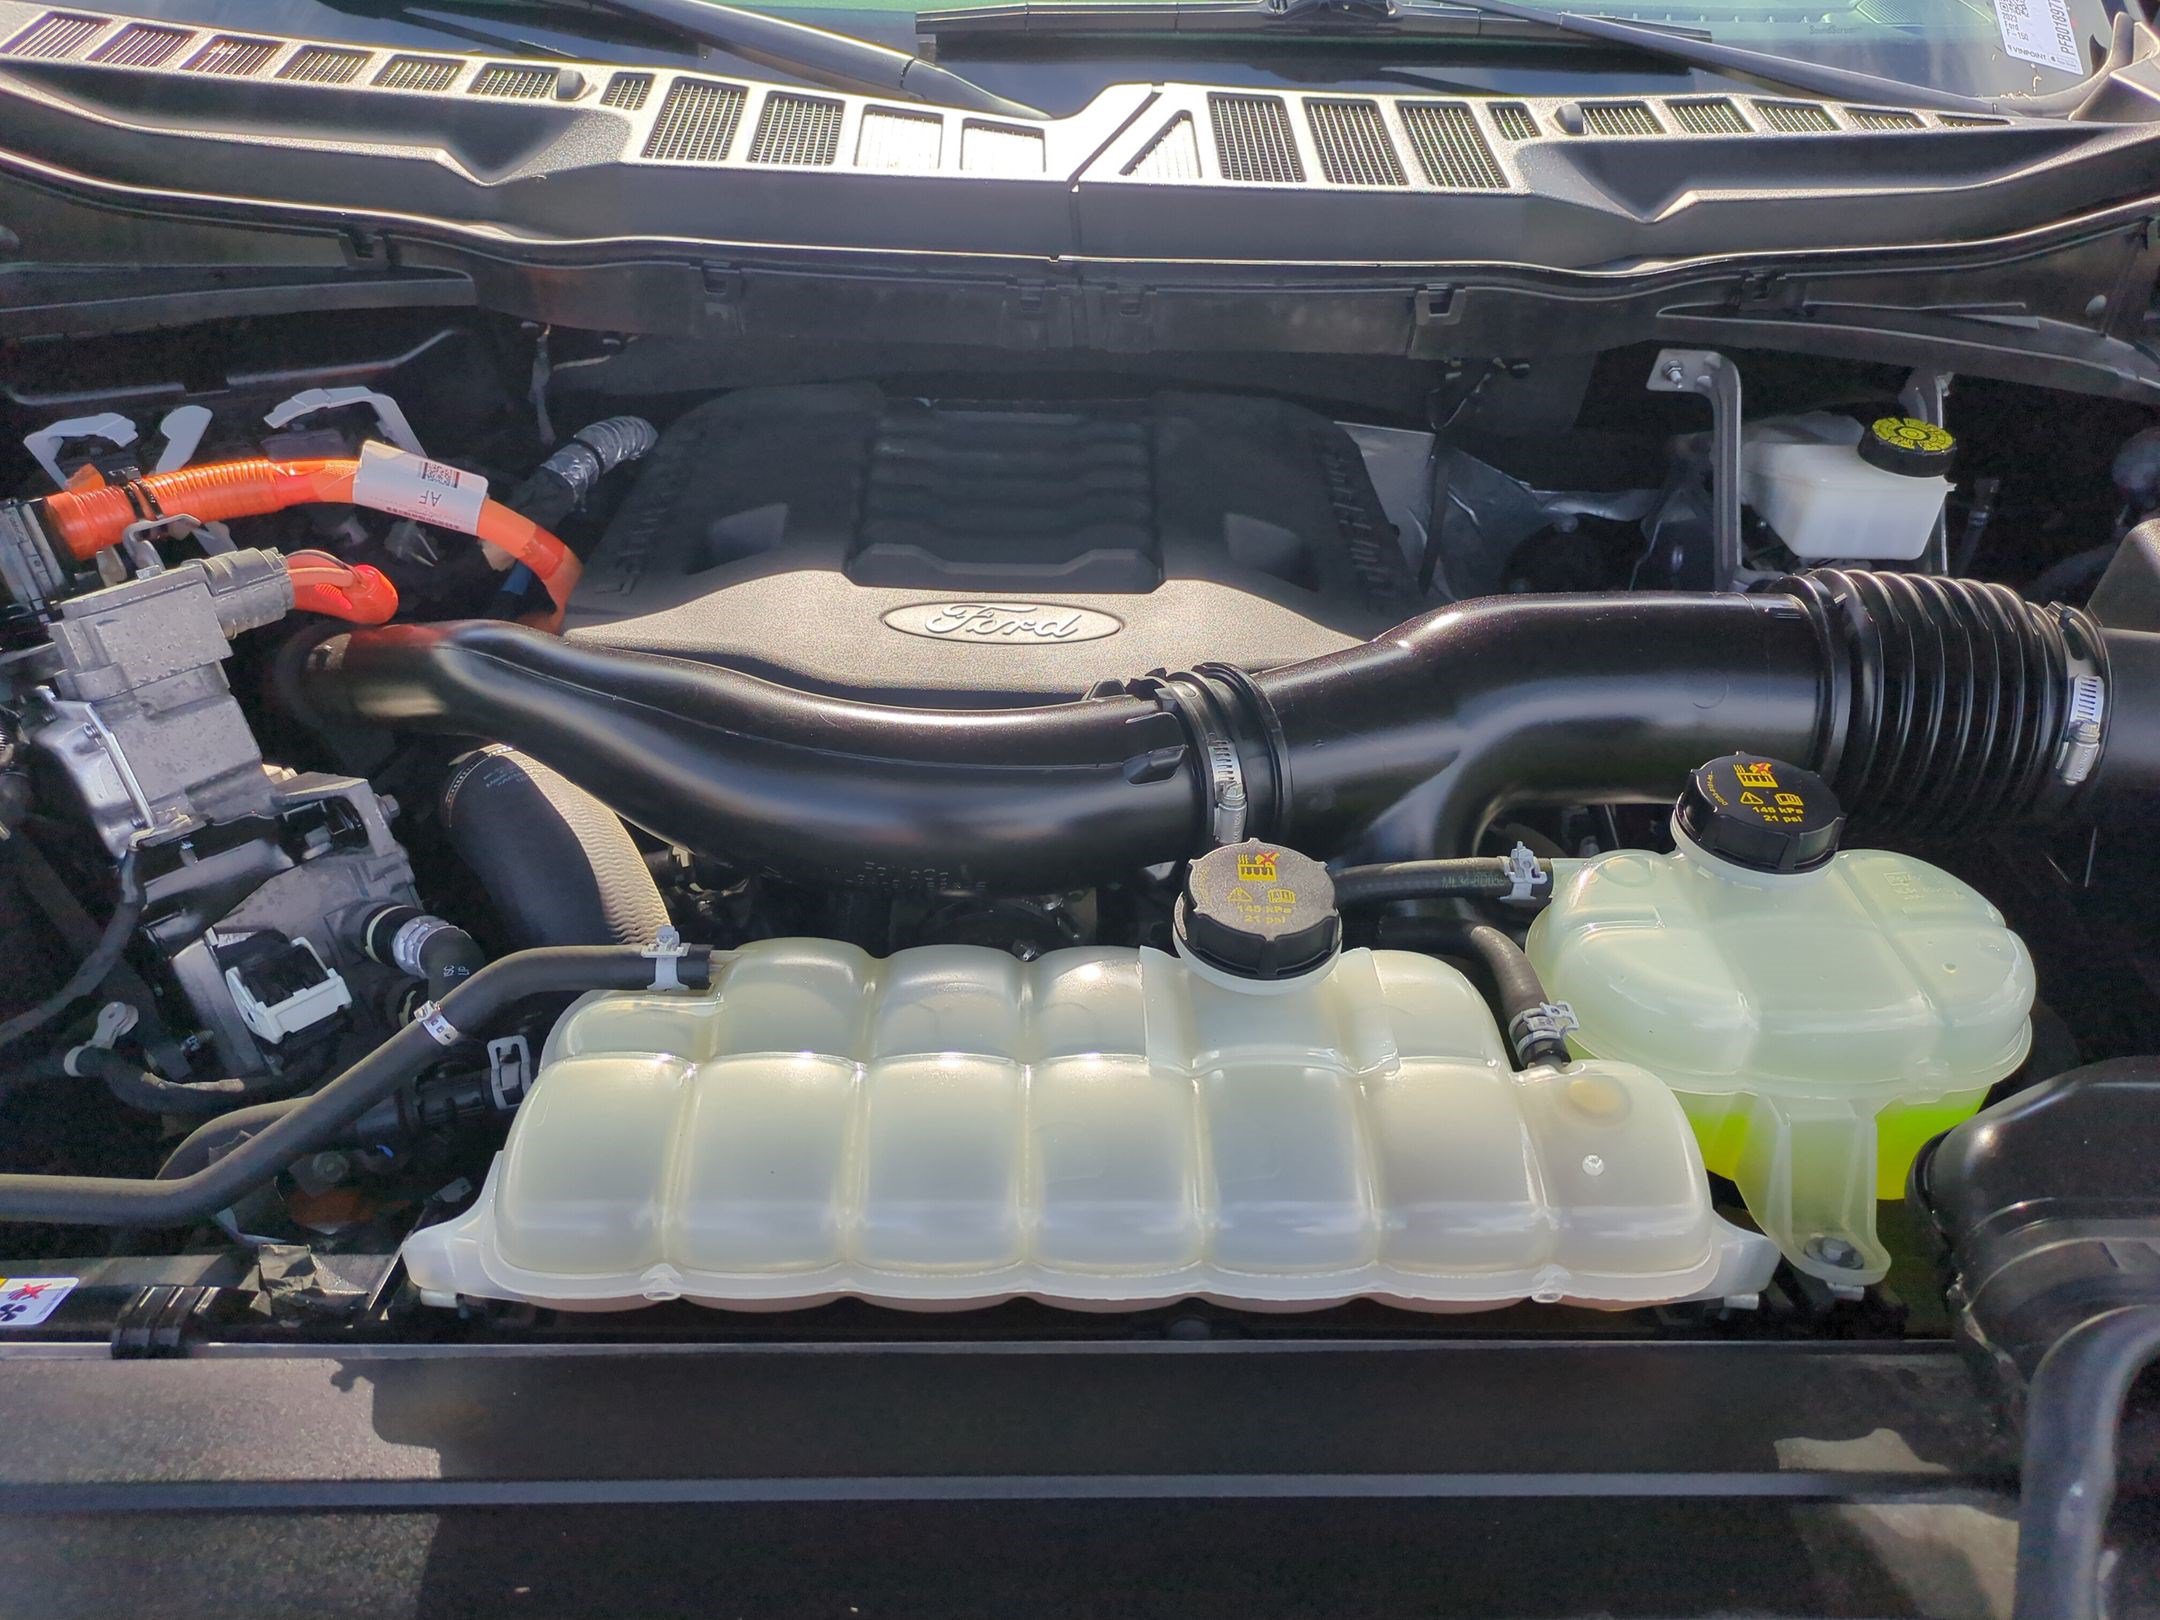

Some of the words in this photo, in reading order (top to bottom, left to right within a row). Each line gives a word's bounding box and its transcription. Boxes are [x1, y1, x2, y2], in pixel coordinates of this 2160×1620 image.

[2004, 21, 2020, 31] Ford
[2006, 28, 2029, 41] F-150
[2012, 46, 2047, 60] VINPOINT
[418, 489, 442, 507] AF
[924, 603, 1083, 638] Ford
[1763, 814, 1779, 822] 21
[1265, 905, 1292, 914] kPa
[1244, 915, 1261, 923] 21
[1265, 916, 1286, 924] psi
